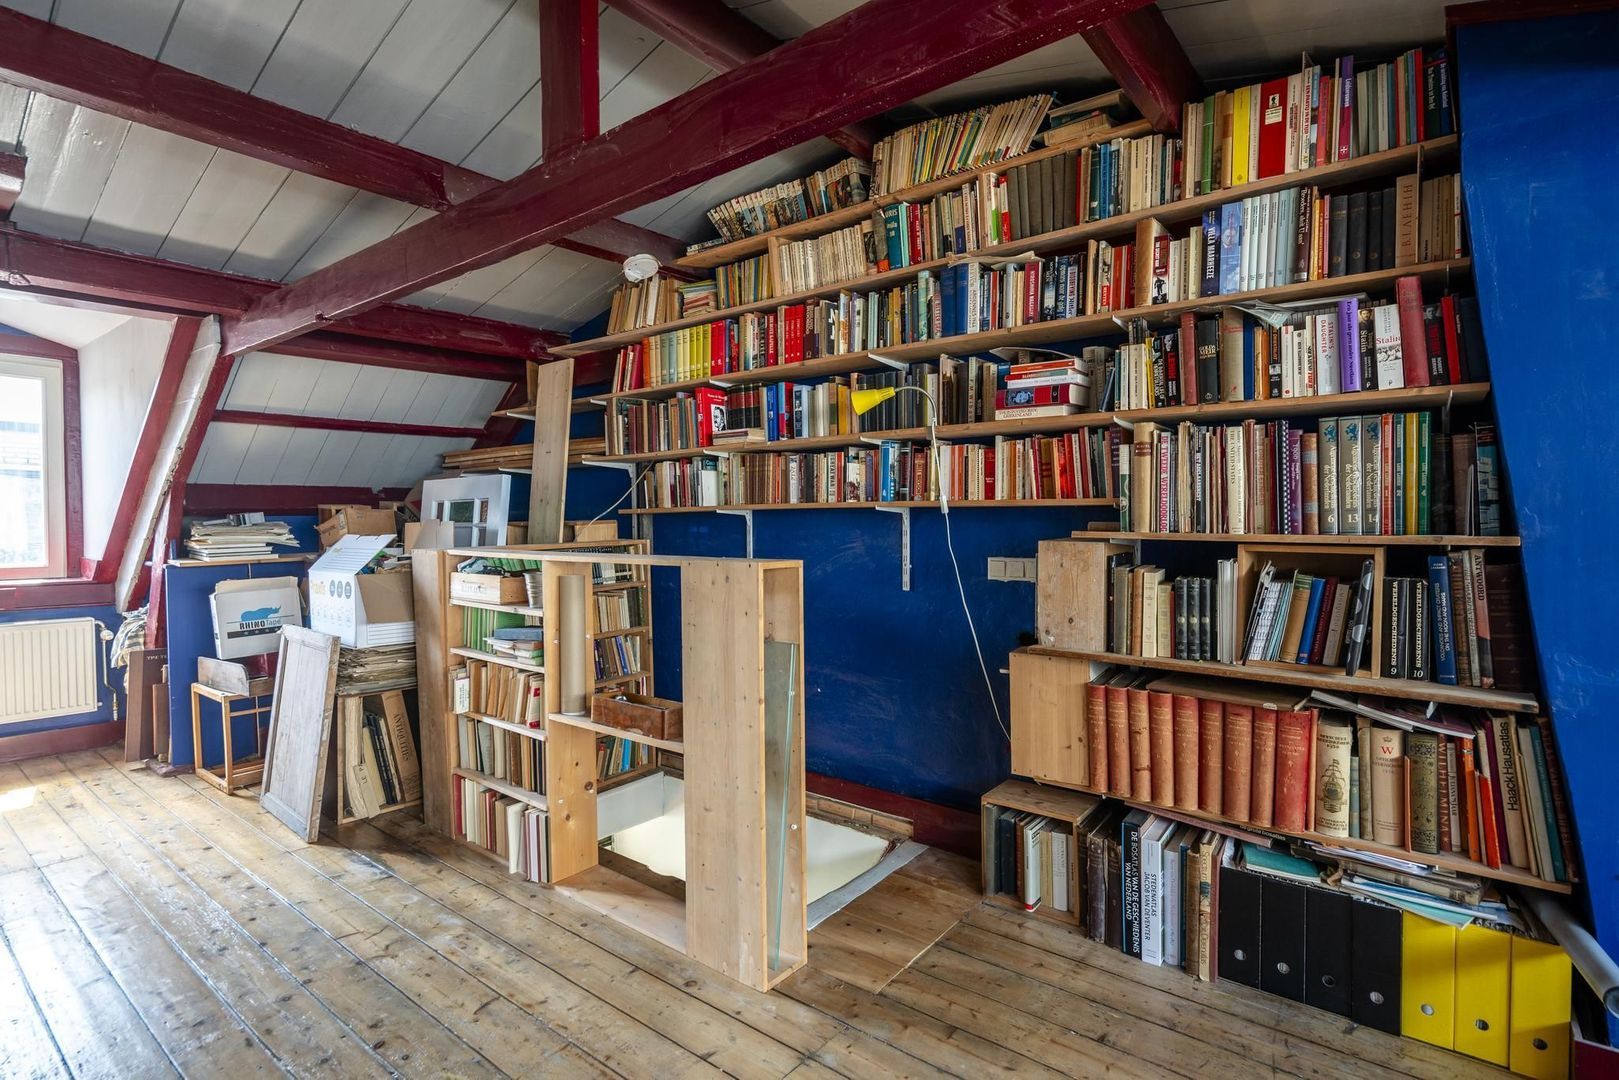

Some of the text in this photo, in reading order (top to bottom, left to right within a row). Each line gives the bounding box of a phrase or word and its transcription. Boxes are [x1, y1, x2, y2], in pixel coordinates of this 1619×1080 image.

[1208, 227, 1216, 244] VILLA
[1206, 245, 1216, 280] MAARHEEZE
[1376, 334, 1400, 345] Stalin
[1168, 352, 1176, 380] LENIN
[1161, 436, 1169, 445] DE
[1161, 446, 1169, 474] TWEEDE
[1328, 514, 1334, 522] 6
[1348, 514, 1359, 522] 13
[1368, 514, 1378, 522] 14
[1475, 554, 1484, 600] ANTWOORD
[239, 618, 282, 630] RHINO Tape
[1390, 667, 1397, 675] 9
[1414, 670, 1424, 678] 10
[393, 713, 410, 762] ANTIQUITIES
[1381, 746, 1394, 754] W
[1500, 721, 1518, 811] Haack Hausatlas
[1438, 742, 1449, 832] WILHELMINA
[1131, 831, 1138, 842] DE
[1131, 843, 1139, 875] BOSATLAS
[1132, 892, 1140, 902] DE
